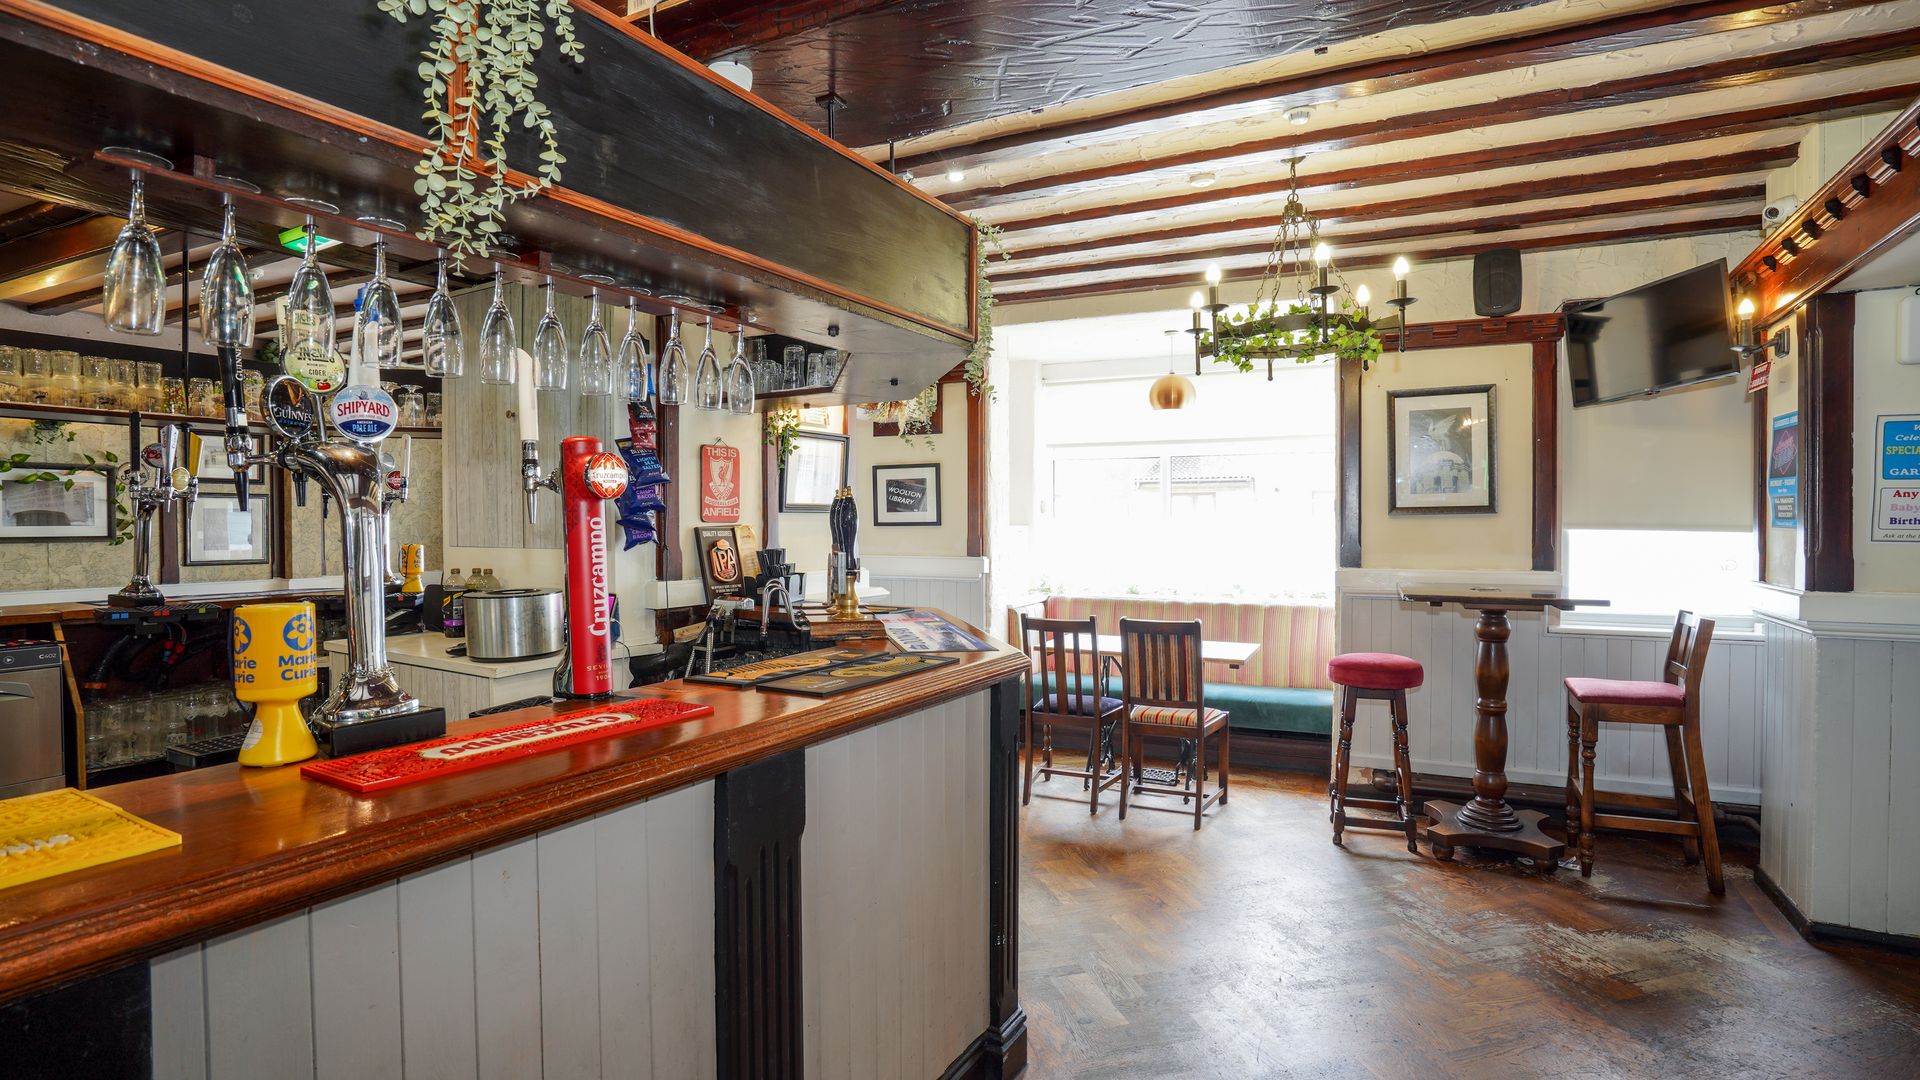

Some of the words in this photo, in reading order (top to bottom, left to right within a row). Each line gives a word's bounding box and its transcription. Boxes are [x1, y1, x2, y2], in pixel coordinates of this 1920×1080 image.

[337, 401, 390, 417] SHIPYARD
[352, 424, 366, 432] PALE
[367, 424, 378, 432] ALE
[706, 448, 726, 457] THIS
[728, 449, 737, 458] IS
[888, 487, 921, 498] WOOLTON
[1893, 490, 1919, 499] Any
[888, 495, 915, 504] LIBRARY
[703, 507, 740, 517] ANFIELD
[1890, 503, 1920, 513] Baby
[713, 548, 735, 572] IPA
[587, 517, 607, 637] Cruzcampo
[234, 656, 257, 669] arie
[234, 671, 255, 684] urie
